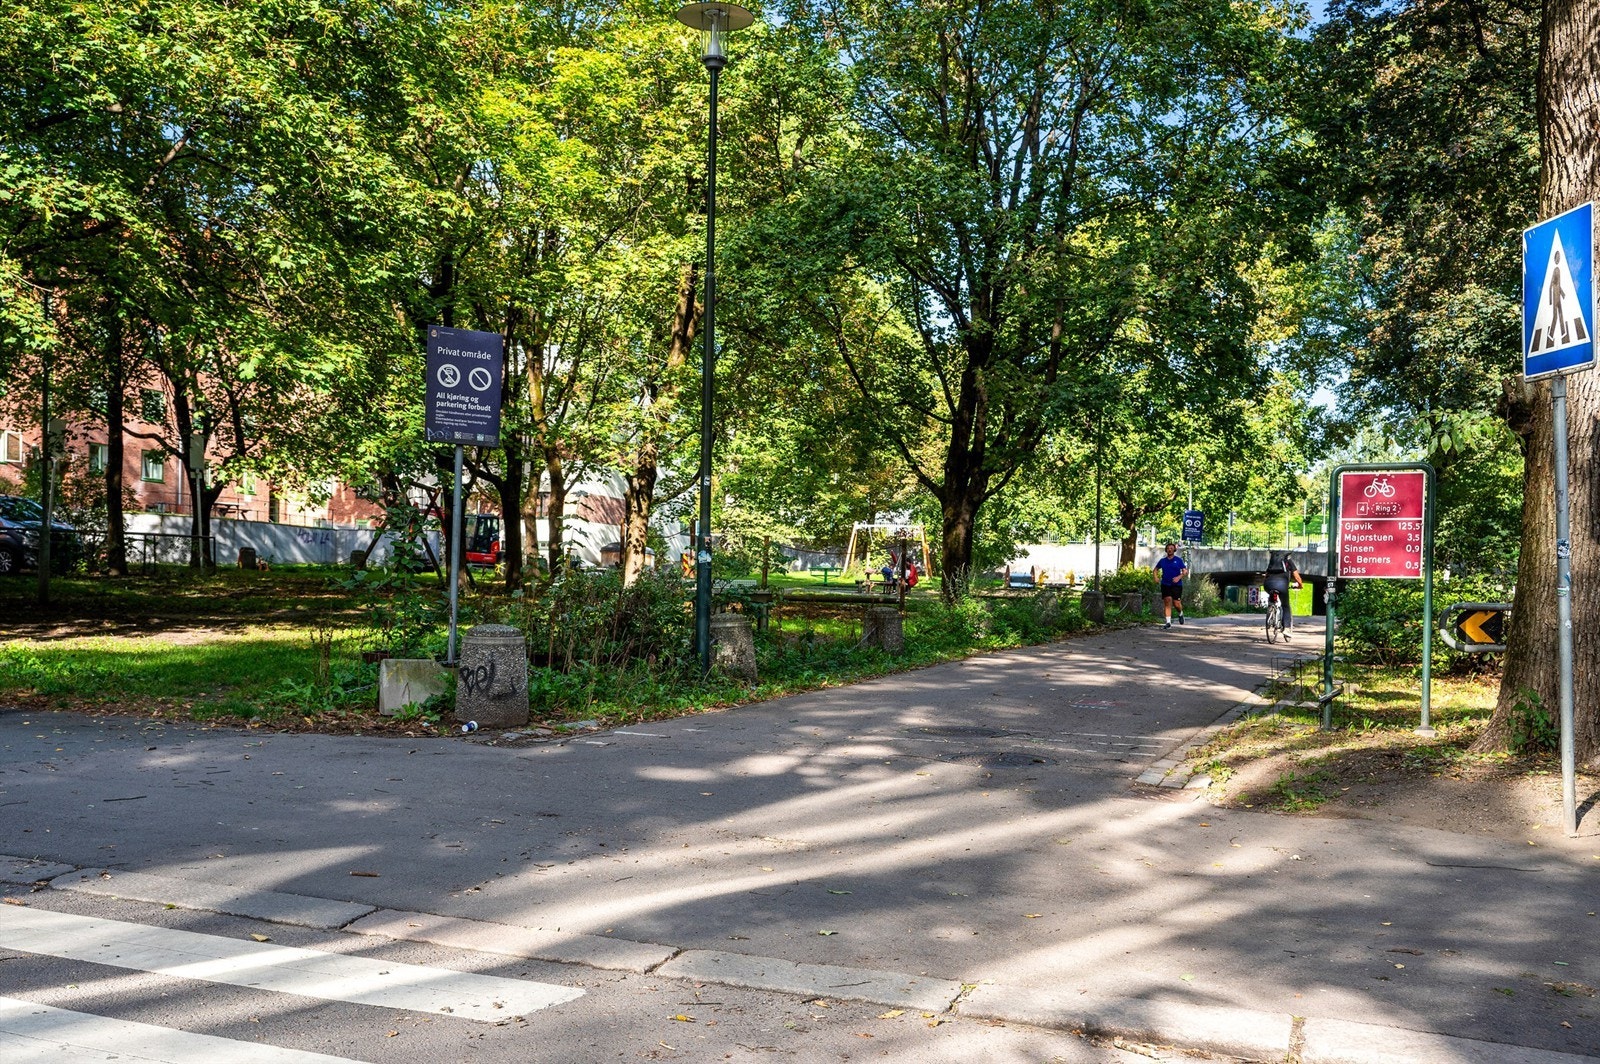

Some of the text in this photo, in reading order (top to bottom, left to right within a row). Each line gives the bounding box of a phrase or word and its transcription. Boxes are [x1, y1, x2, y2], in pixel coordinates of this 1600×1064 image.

[437, 346, 492, 360] Privat område
[446, 392, 470, 403] kjøring
[470, 396, 479, 404] og
[436, 401, 491, 411] parkering forbudt
[1375, 505, 1391, 513] Ring
[1344, 522, 1373, 532] Gjøvik
[1344, 533, 1394, 543] Majorstuen
[1344, 544, 1374, 553] Sinsen
[1343, 555, 1391, 564] C. Berners
[1343, 566, 1367, 575] plass
